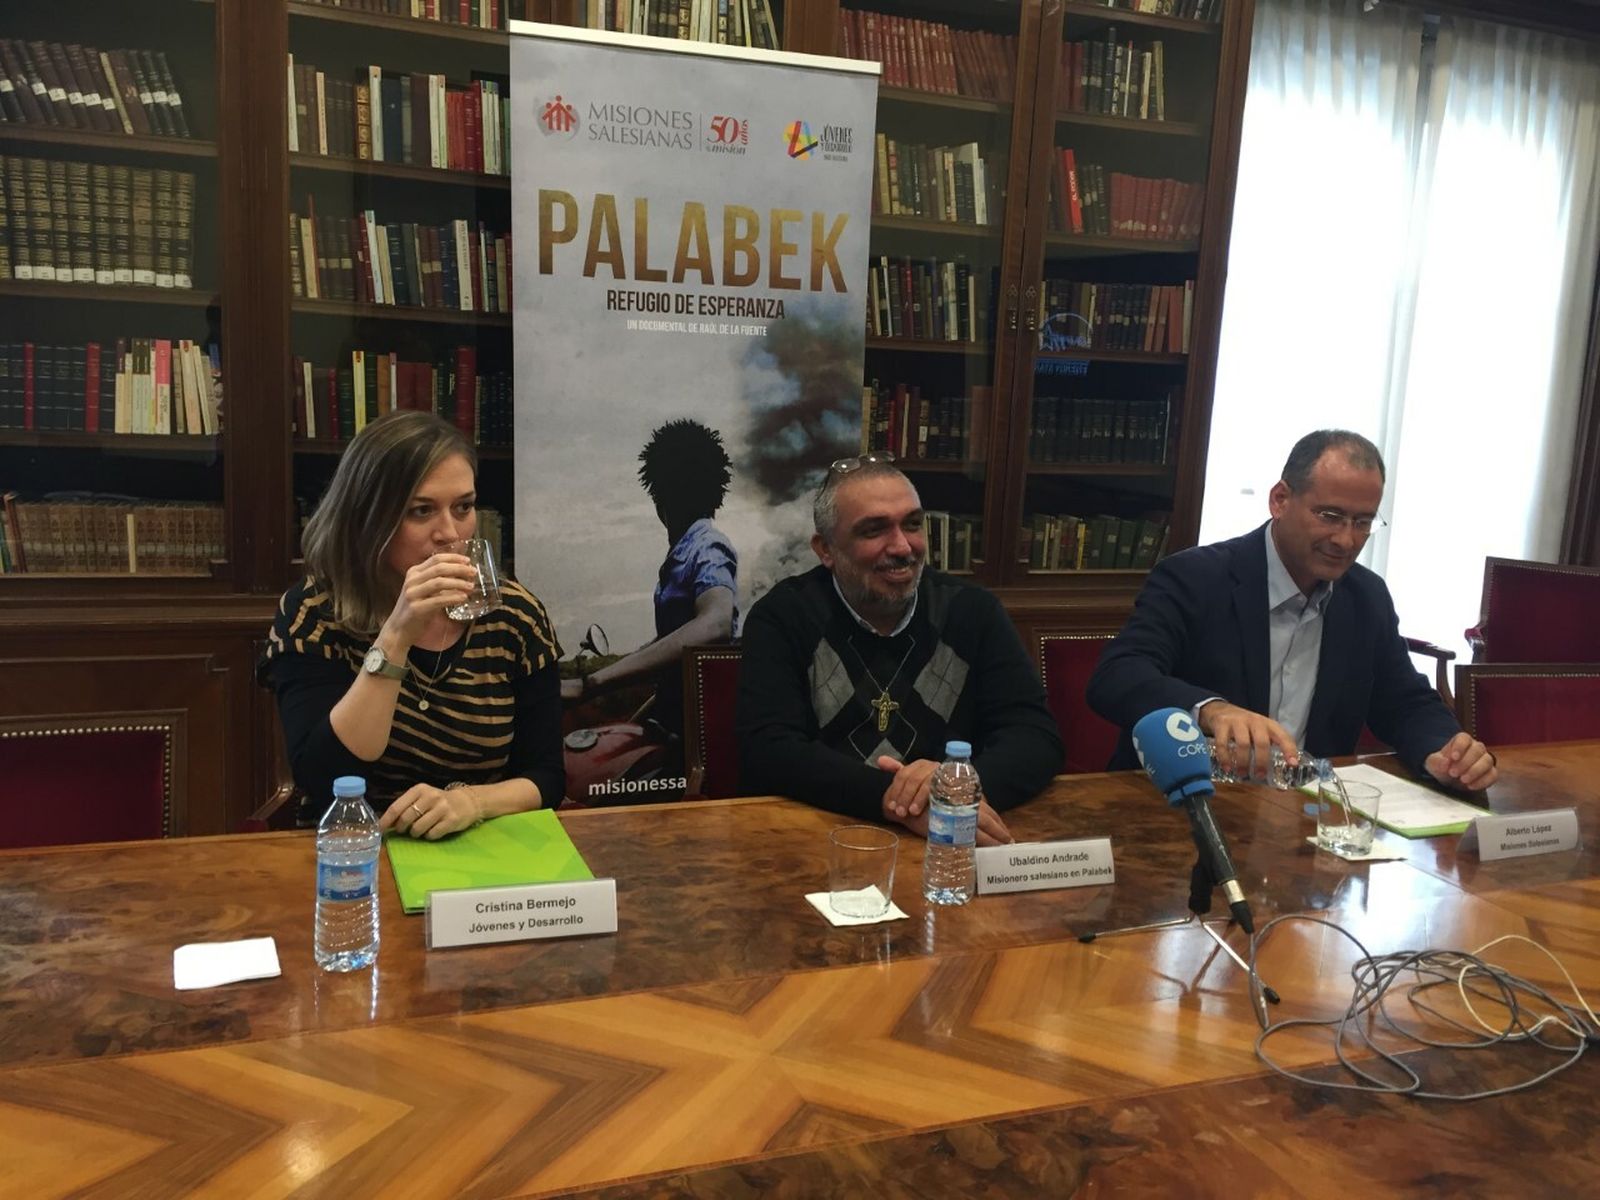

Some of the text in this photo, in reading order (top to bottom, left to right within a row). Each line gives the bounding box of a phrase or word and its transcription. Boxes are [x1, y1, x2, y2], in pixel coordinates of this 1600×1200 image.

[588, 102, 693, 130] MISIONES
[588, 123, 693, 150] SALESIANAS
[706, 115, 740, 144] 50
[740, 119, 749, 145] años
[538, 188, 848, 293] PALABEK
[607, 289, 785, 319] REFUGIO DE ESPERANZA
[627, 320, 637, 330] UN
[638, 320, 687, 333] DOCUMENTAL
[688, 323, 699, 333] DE
[719, 325, 729, 335] DE
[730, 325, 740, 335] LA
[741, 326, 767, 337] FUENTE
[588, 777, 687, 796] misionessa
[1506, 824, 1552, 836] Alberto López
[1009, 852, 1089, 867] Ubaldino Andrade
[987, 874, 1028, 885] Misionero
[1030, 870, 1069, 881] salesiano
[1082, 866, 1112, 876] Palabek
[475, 896, 576, 914] Cristina Bermejo
[469, 915, 583, 933] Jóvenes y Desarrollo
